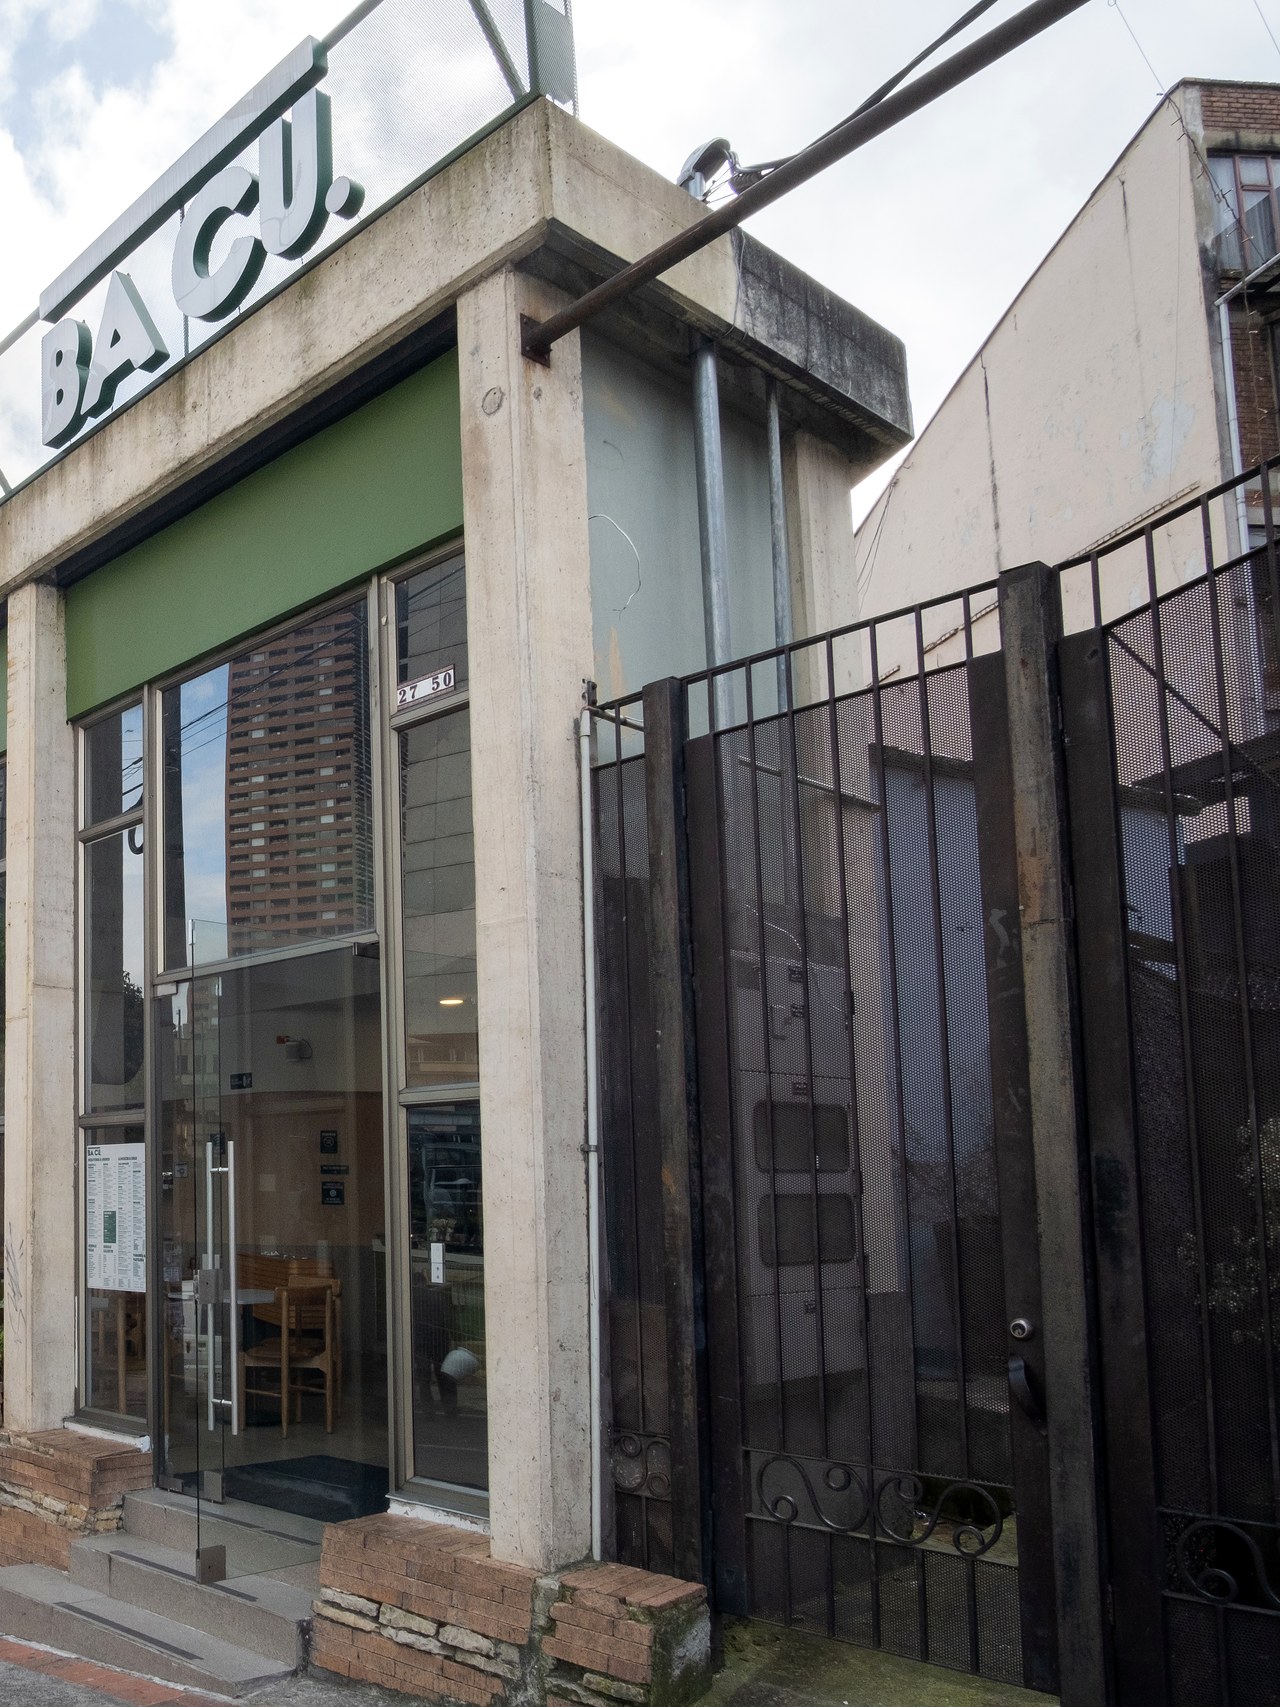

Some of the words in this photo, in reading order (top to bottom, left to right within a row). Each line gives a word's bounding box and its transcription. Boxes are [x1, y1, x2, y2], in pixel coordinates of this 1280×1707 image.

[41, 270, 170, 450] BA
[399, 684, 418, 704] 27
[431, 672, 452, 691] 50
